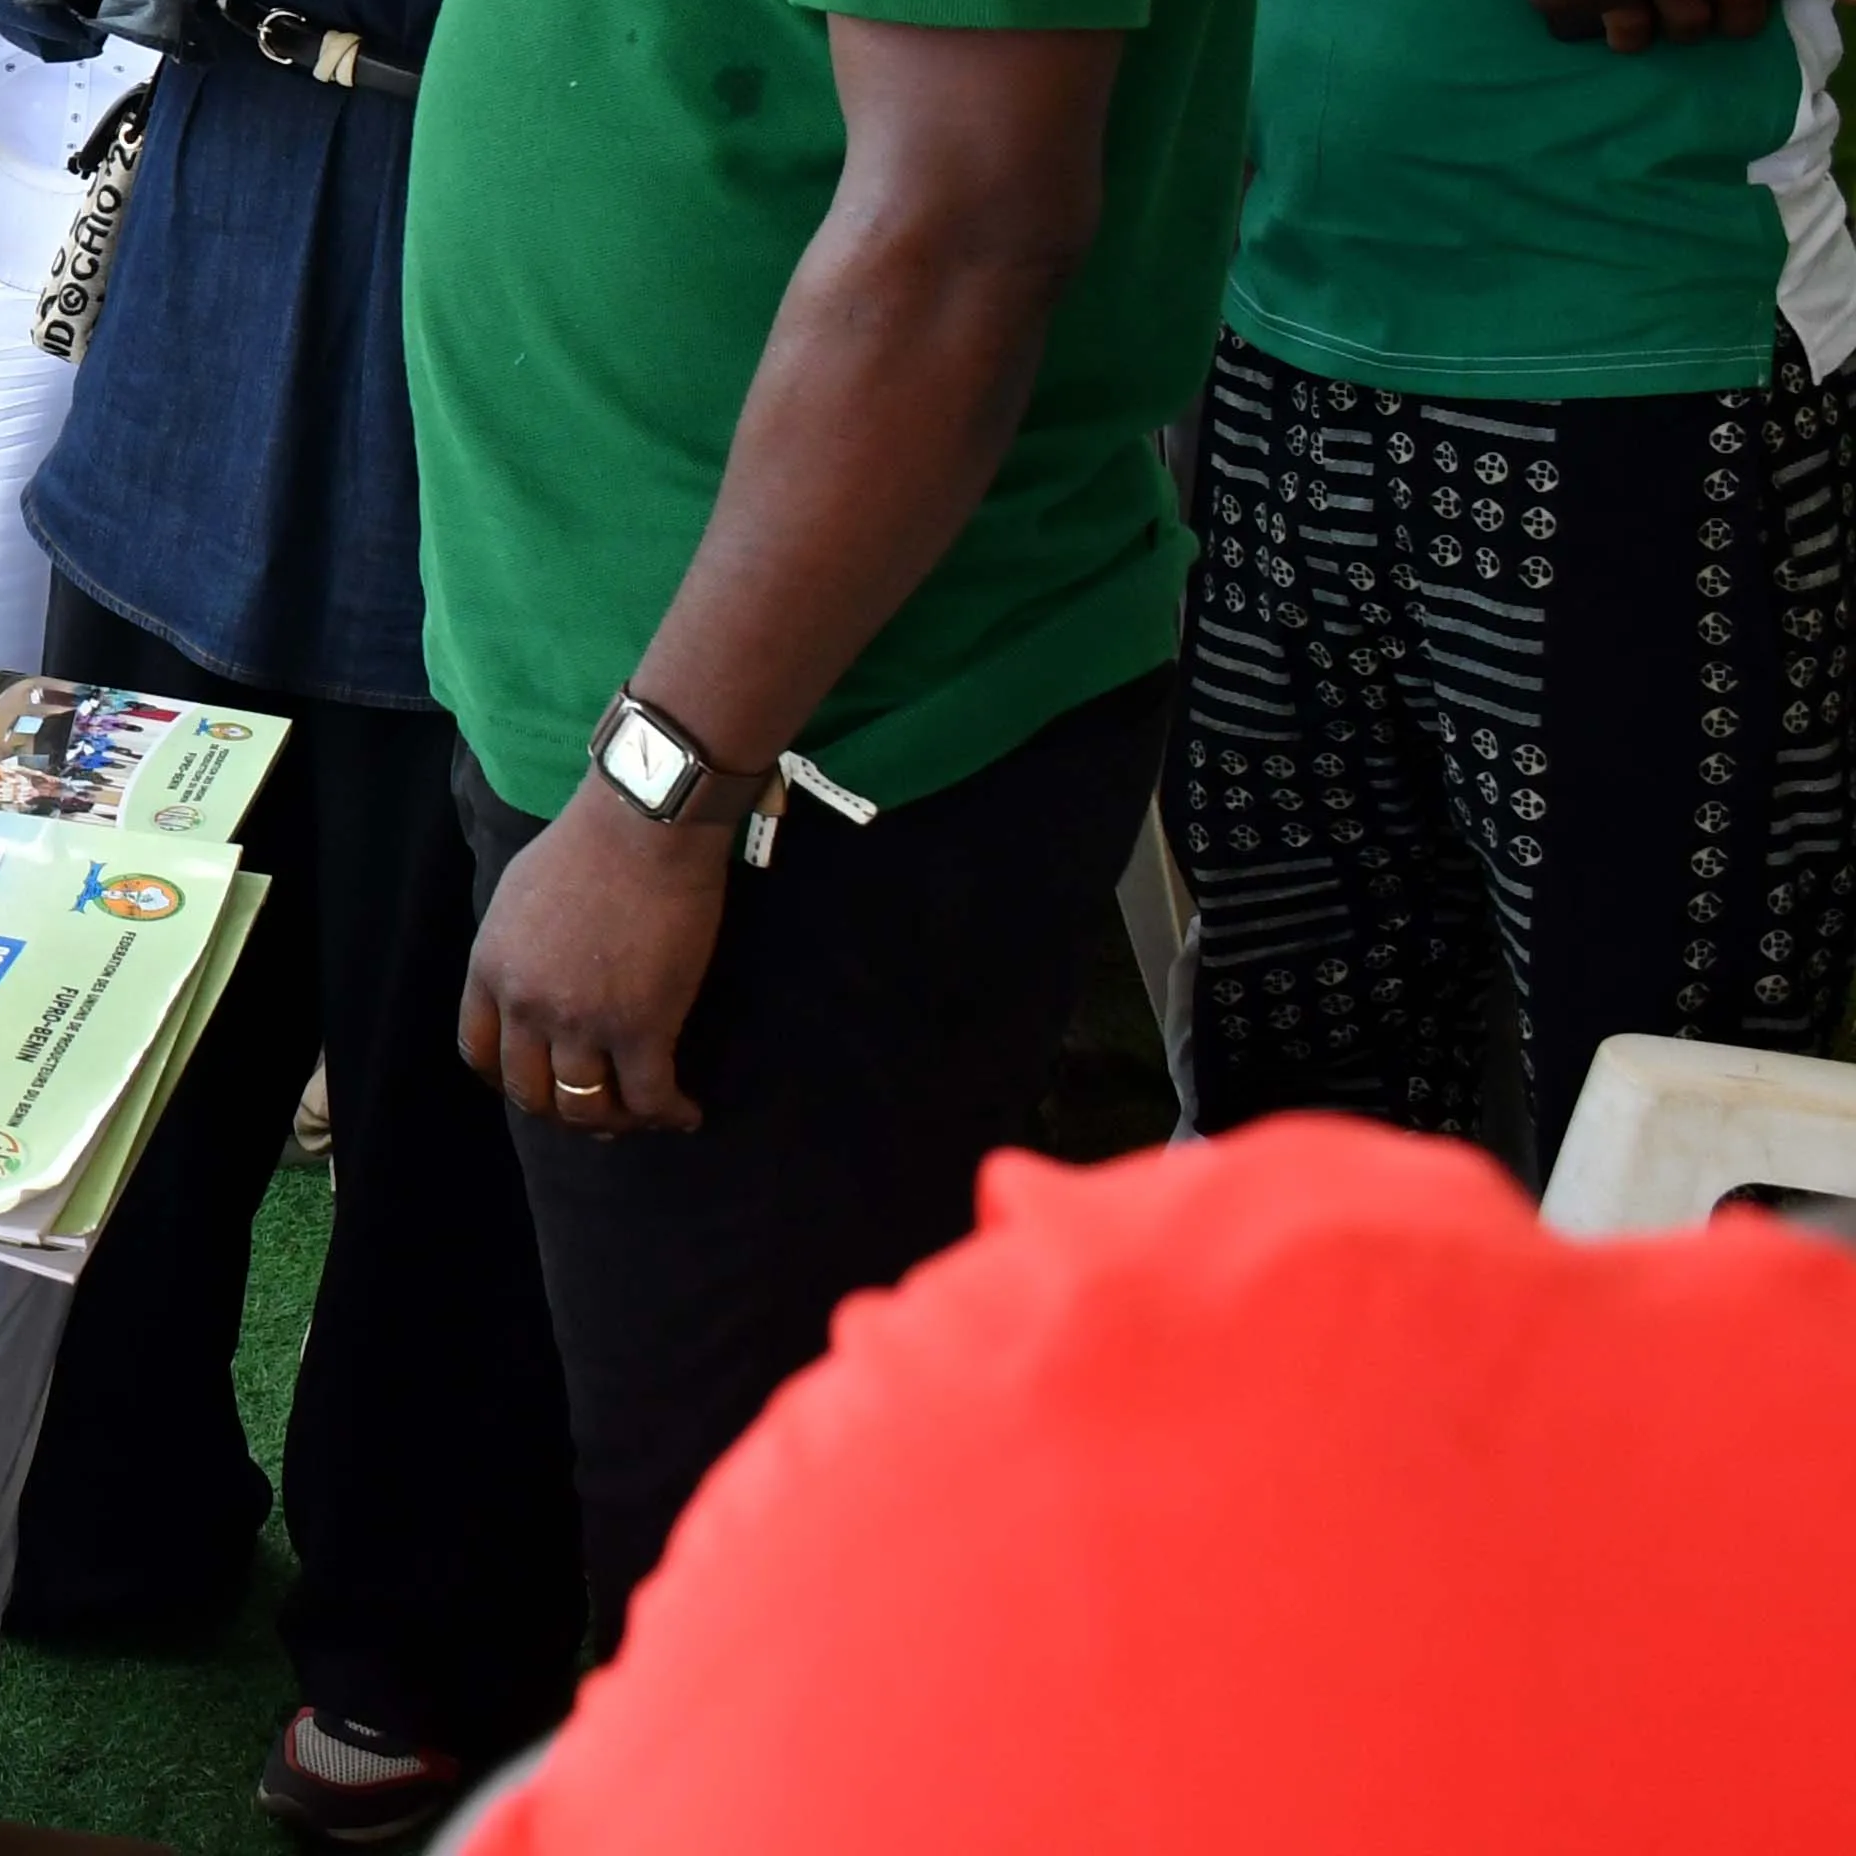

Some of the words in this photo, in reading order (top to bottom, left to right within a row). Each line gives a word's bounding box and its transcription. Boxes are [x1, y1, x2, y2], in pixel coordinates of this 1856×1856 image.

[104, 930, 137, 979] FEDERATION
[15, 985, 80, 1064] FUPRO-BENIN
[7, 1101, 31, 1128] BENIN
